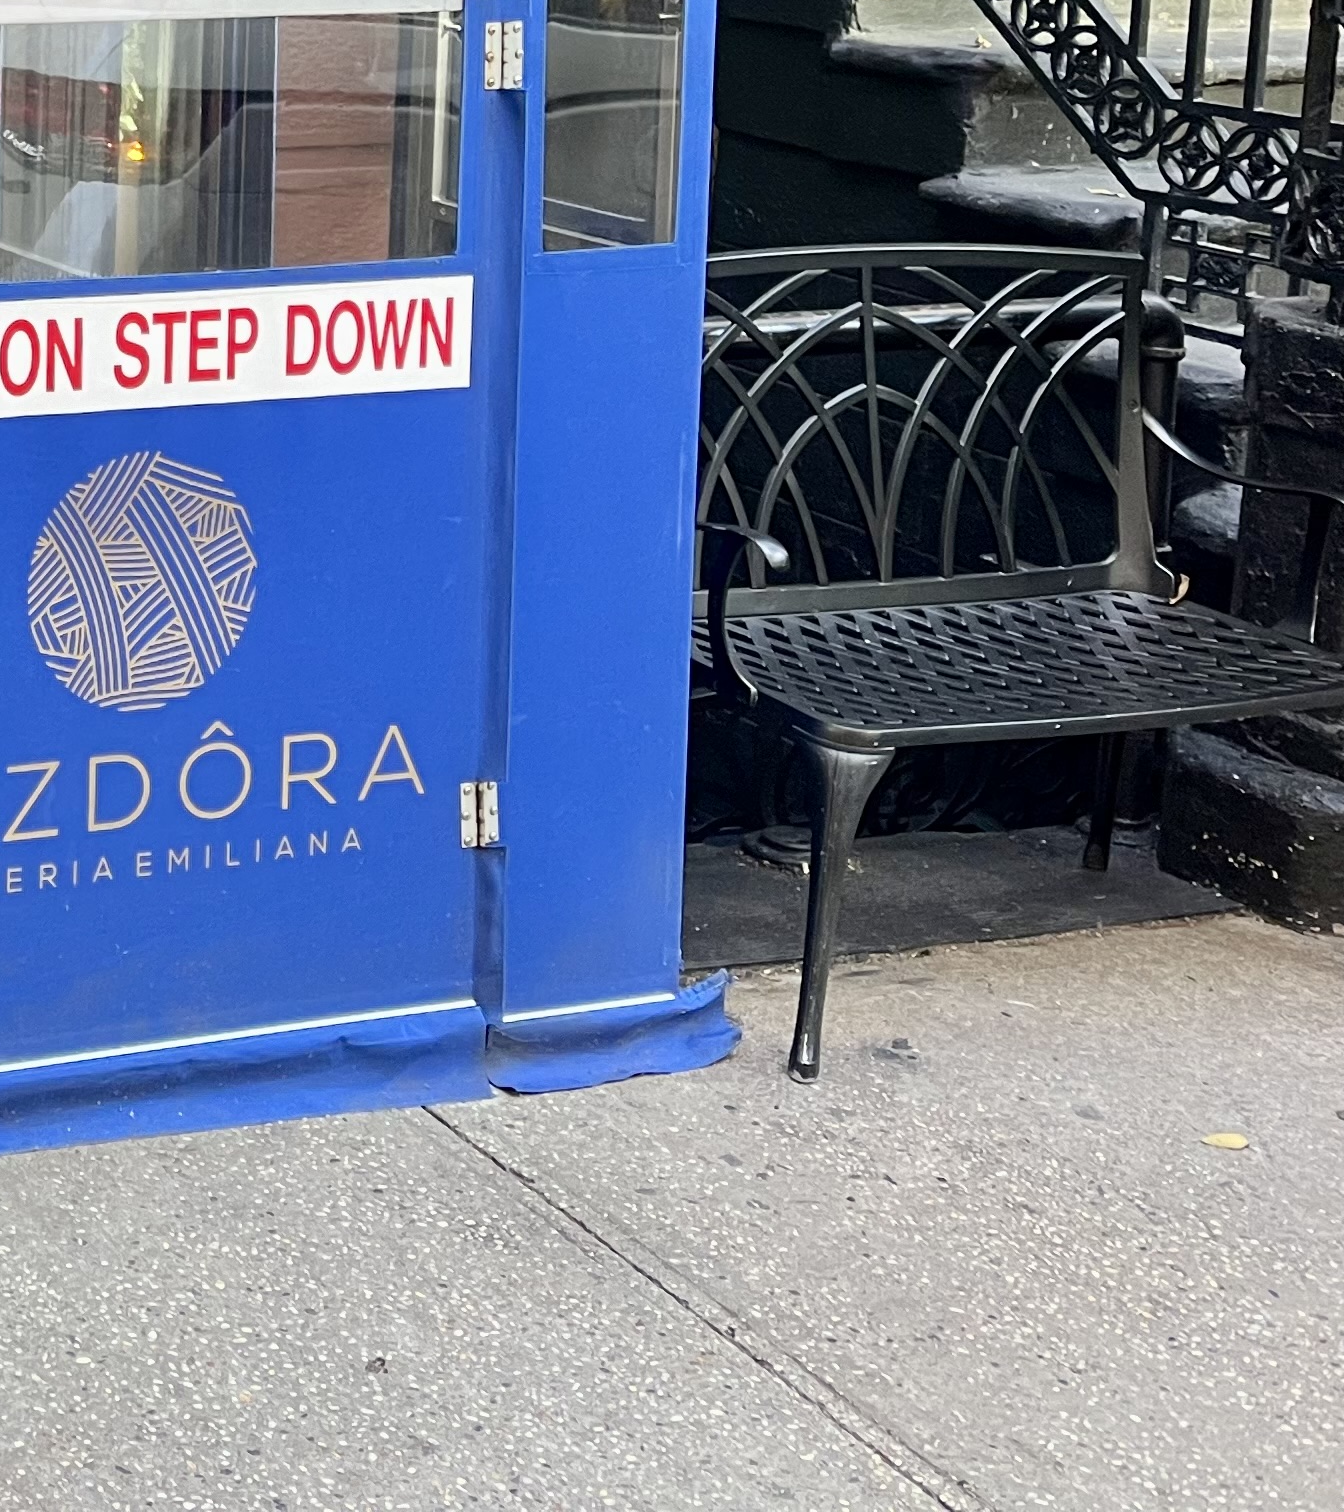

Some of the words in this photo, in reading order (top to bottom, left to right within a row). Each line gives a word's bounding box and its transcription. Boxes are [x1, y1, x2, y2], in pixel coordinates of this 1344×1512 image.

[114, 307, 259, 389] STEP
[286, 298, 454, 376] DOWN
[136, 828, 362, 878] EMILIANA
